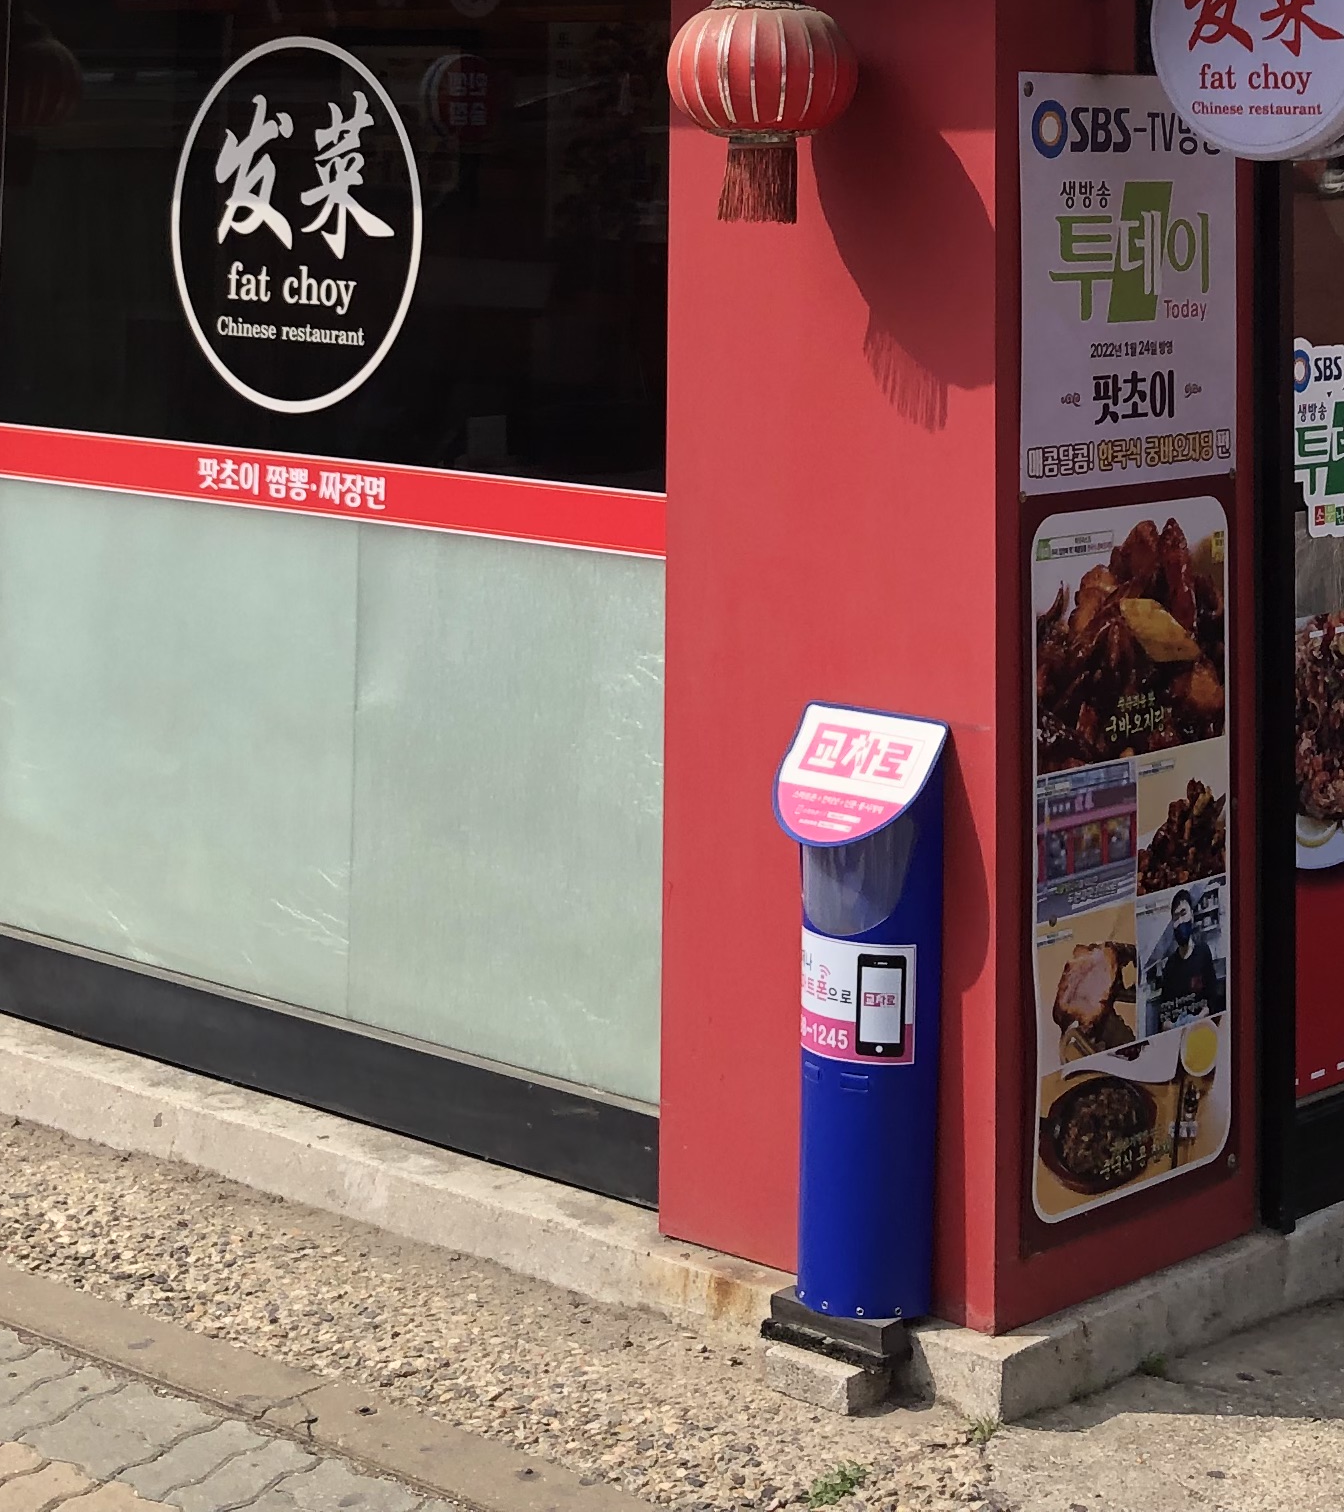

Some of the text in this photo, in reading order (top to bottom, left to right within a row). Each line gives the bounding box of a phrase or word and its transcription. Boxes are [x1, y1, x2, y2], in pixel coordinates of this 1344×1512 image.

[1199, 63, 1312, 95] fat choy
[1192, 100, 1323, 116] Chinese restaurant
[1070, 107, 1221, 155] SBS-TV방
[1060, 180, 1111, 209] 생방송
[1049, 210, 1209, 321] 투데이
[227, 261, 357, 315] fat choy
[1164, 299, 1207, 321] Today
[217, 316, 365, 346] Chinese restaurant
[1090, 343, 1122, 358] 2022년
[1138, 341, 1157, 356] 24일
[1314, 356, 1342, 382] SBS
[1093, 370, 1174, 425] 팟초이
[1297, 402, 1327, 423] 생방송
[1027, 441, 1095, 478] 매콤달콤!
[1097, 437, 1142, 471] 한국식
[1216, 429, 1231, 459] 편
[197, 457, 386, 510] 팟초이 짬뽕·짜장면
[802, 724, 914, 780] 교차로
